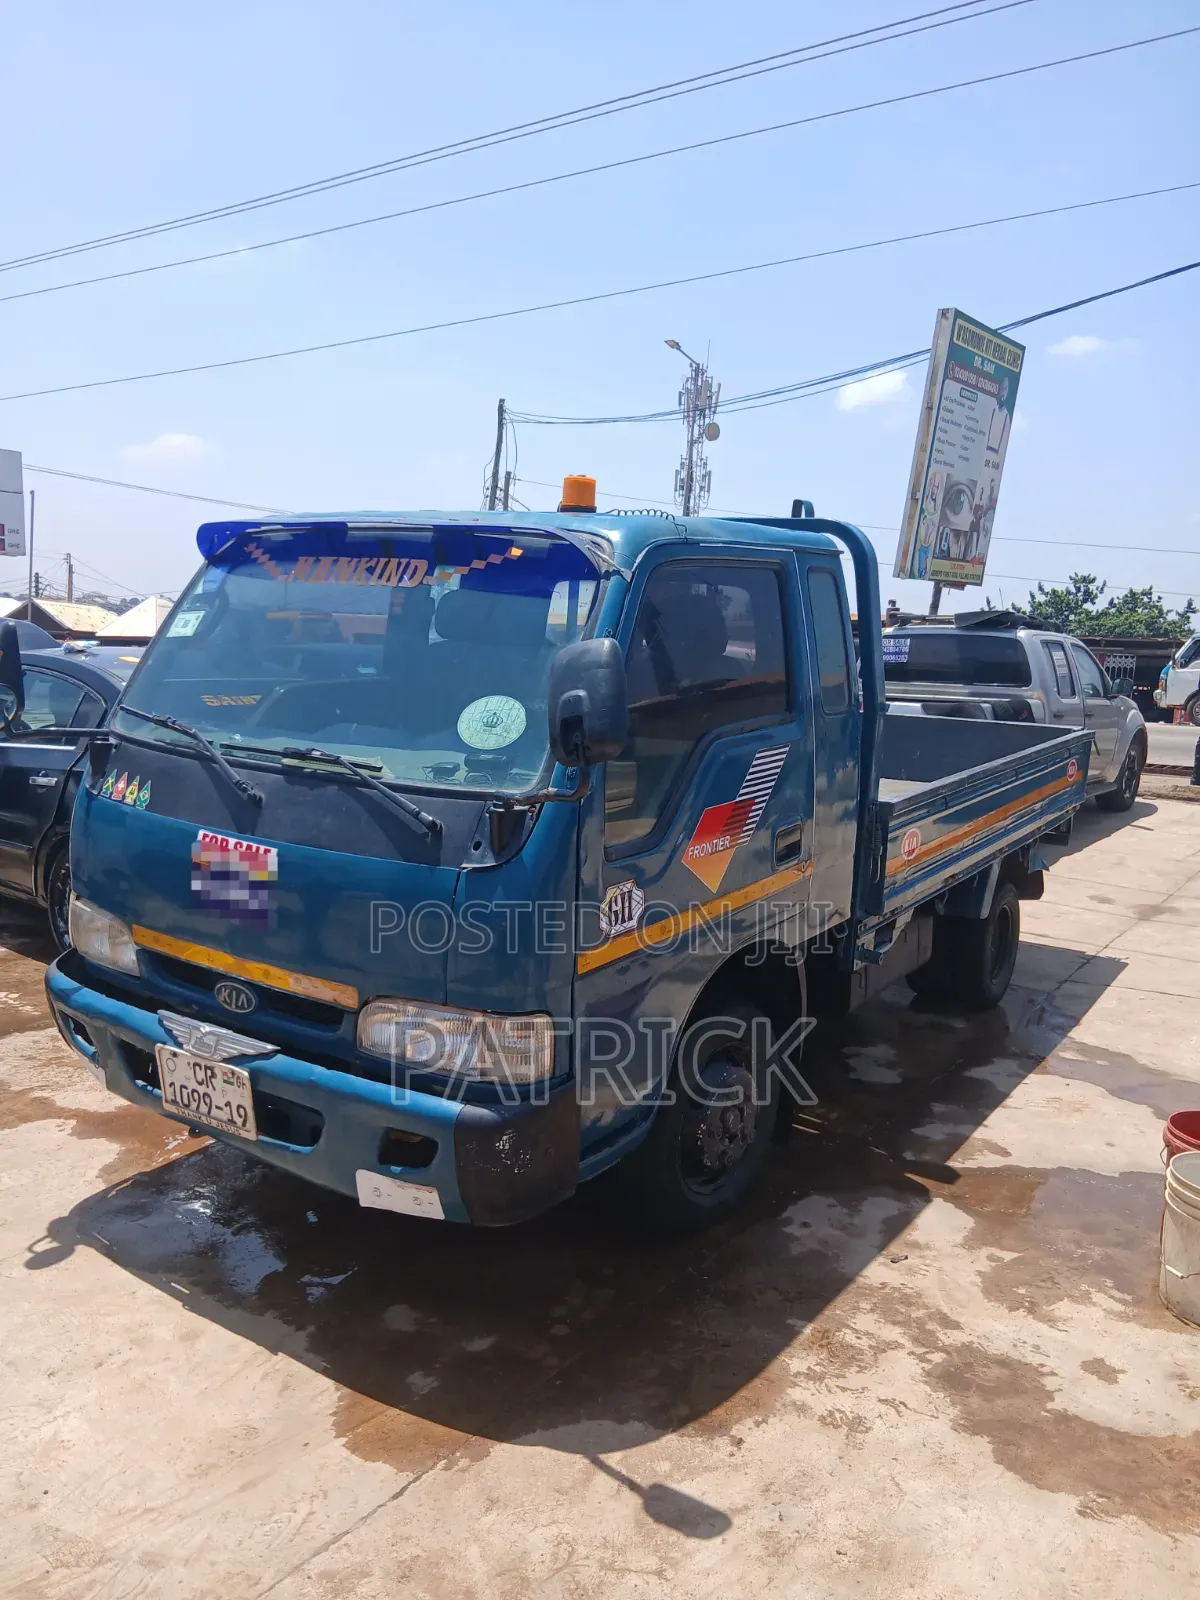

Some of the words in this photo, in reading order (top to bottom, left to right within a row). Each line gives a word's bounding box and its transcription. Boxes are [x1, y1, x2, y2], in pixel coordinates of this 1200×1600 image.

[983, 360, 995, 374] SAM
[688, 835, 730, 861] FRONTIER
[904, 836, 917, 852] KIA
[219, 986, 248, 1009] KIA
[192, 1062, 217, 1091] CR
[169, 1081, 248, 1128] 1099-19
[176, 1107, 204, 1122] THANK
[205, 1116, 212, 1125] U
[216, 1122, 241, 1136] JESUS
